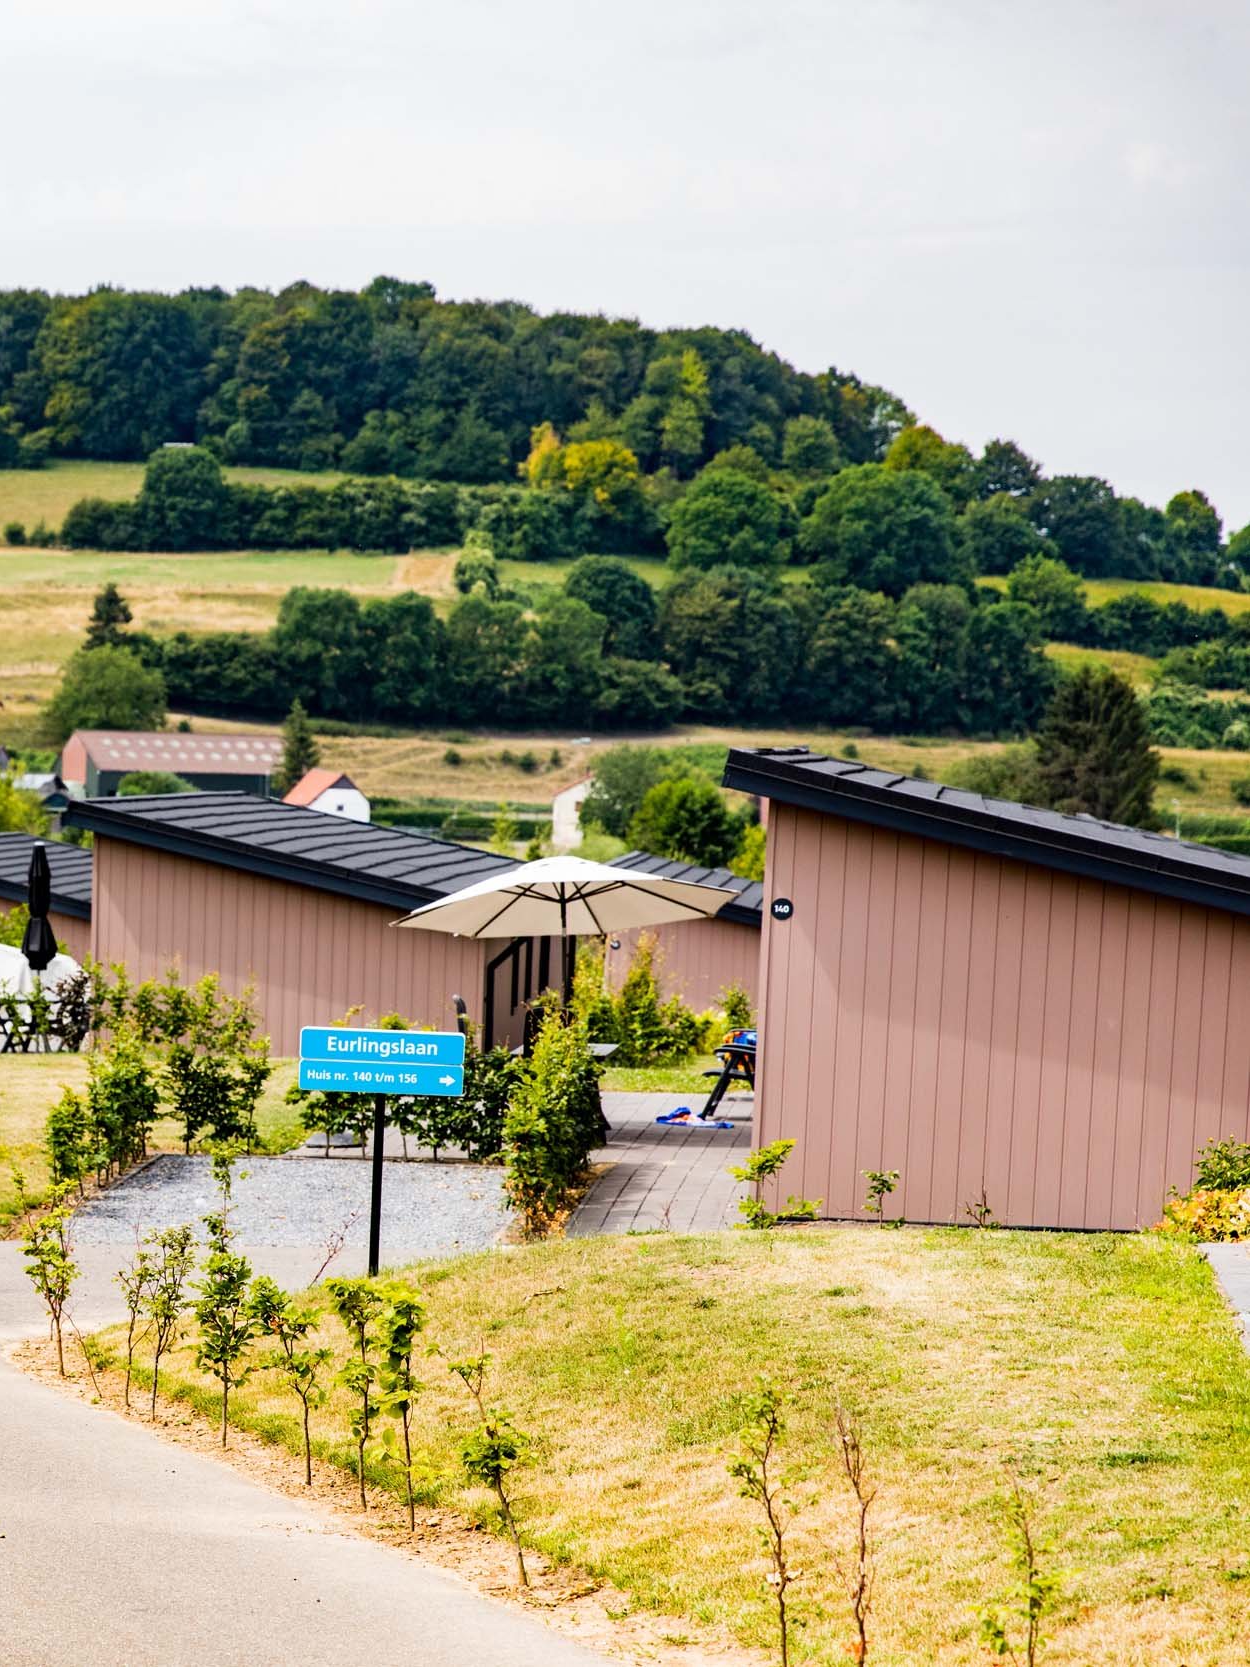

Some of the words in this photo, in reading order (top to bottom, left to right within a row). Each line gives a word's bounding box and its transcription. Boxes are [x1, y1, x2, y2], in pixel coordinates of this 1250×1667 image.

[774, 905, 789, 913] 140
[327, 1036, 438, 1057] Eurlingslaan
[307, 1070, 331, 1080] Huis
[334, 1072, 349, 1081] nr.
[353, 1071, 372, 1082] 140
[375, 1072, 395, 1083] t/m
[398, 1073, 418, 1084] 156
